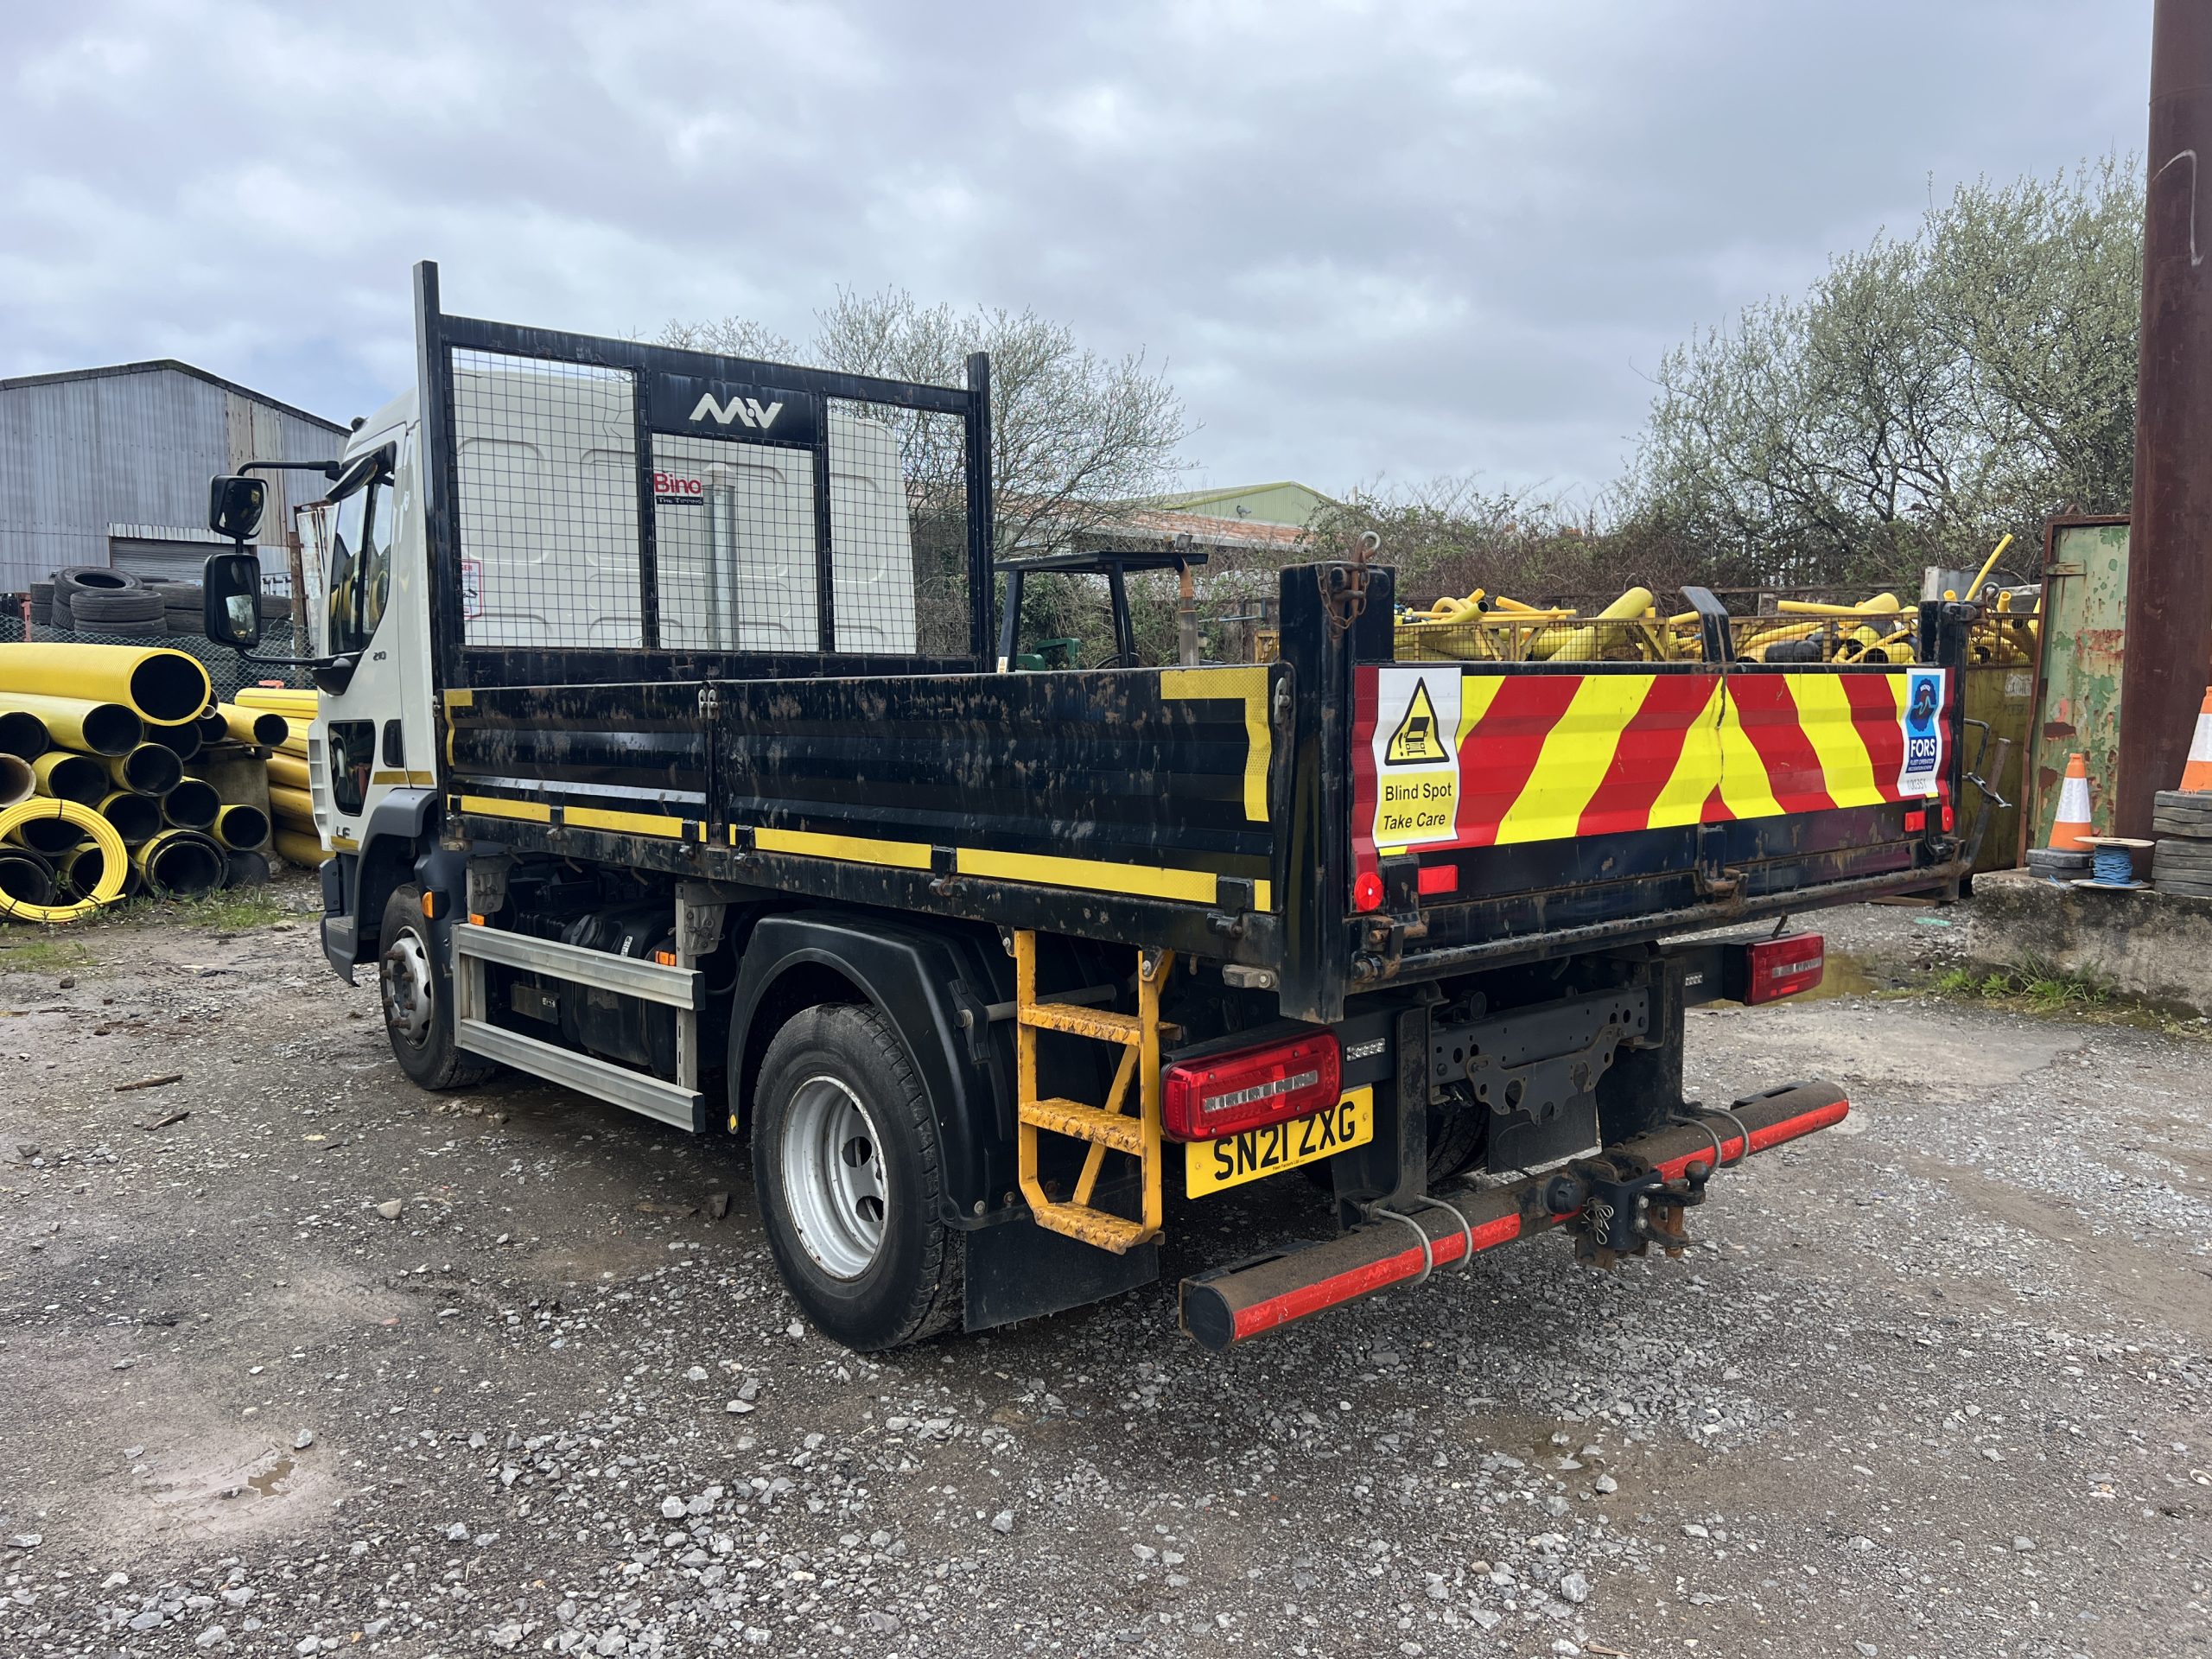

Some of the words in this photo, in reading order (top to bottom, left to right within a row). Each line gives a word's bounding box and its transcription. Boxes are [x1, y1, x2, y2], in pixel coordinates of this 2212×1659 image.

[1910, 739, 1936, 758] FORS
[1385, 784, 1418, 802] Blind
[1422, 782, 1452, 802] Spot
[1383, 814, 1413, 830] Take
[1417, 812, 1446, 827] Care
[336, 826, 350, 838] LF
[1214, 1123, 1287, 1180] SN21
[1299, 1101, 1355, 1157] ZXG
